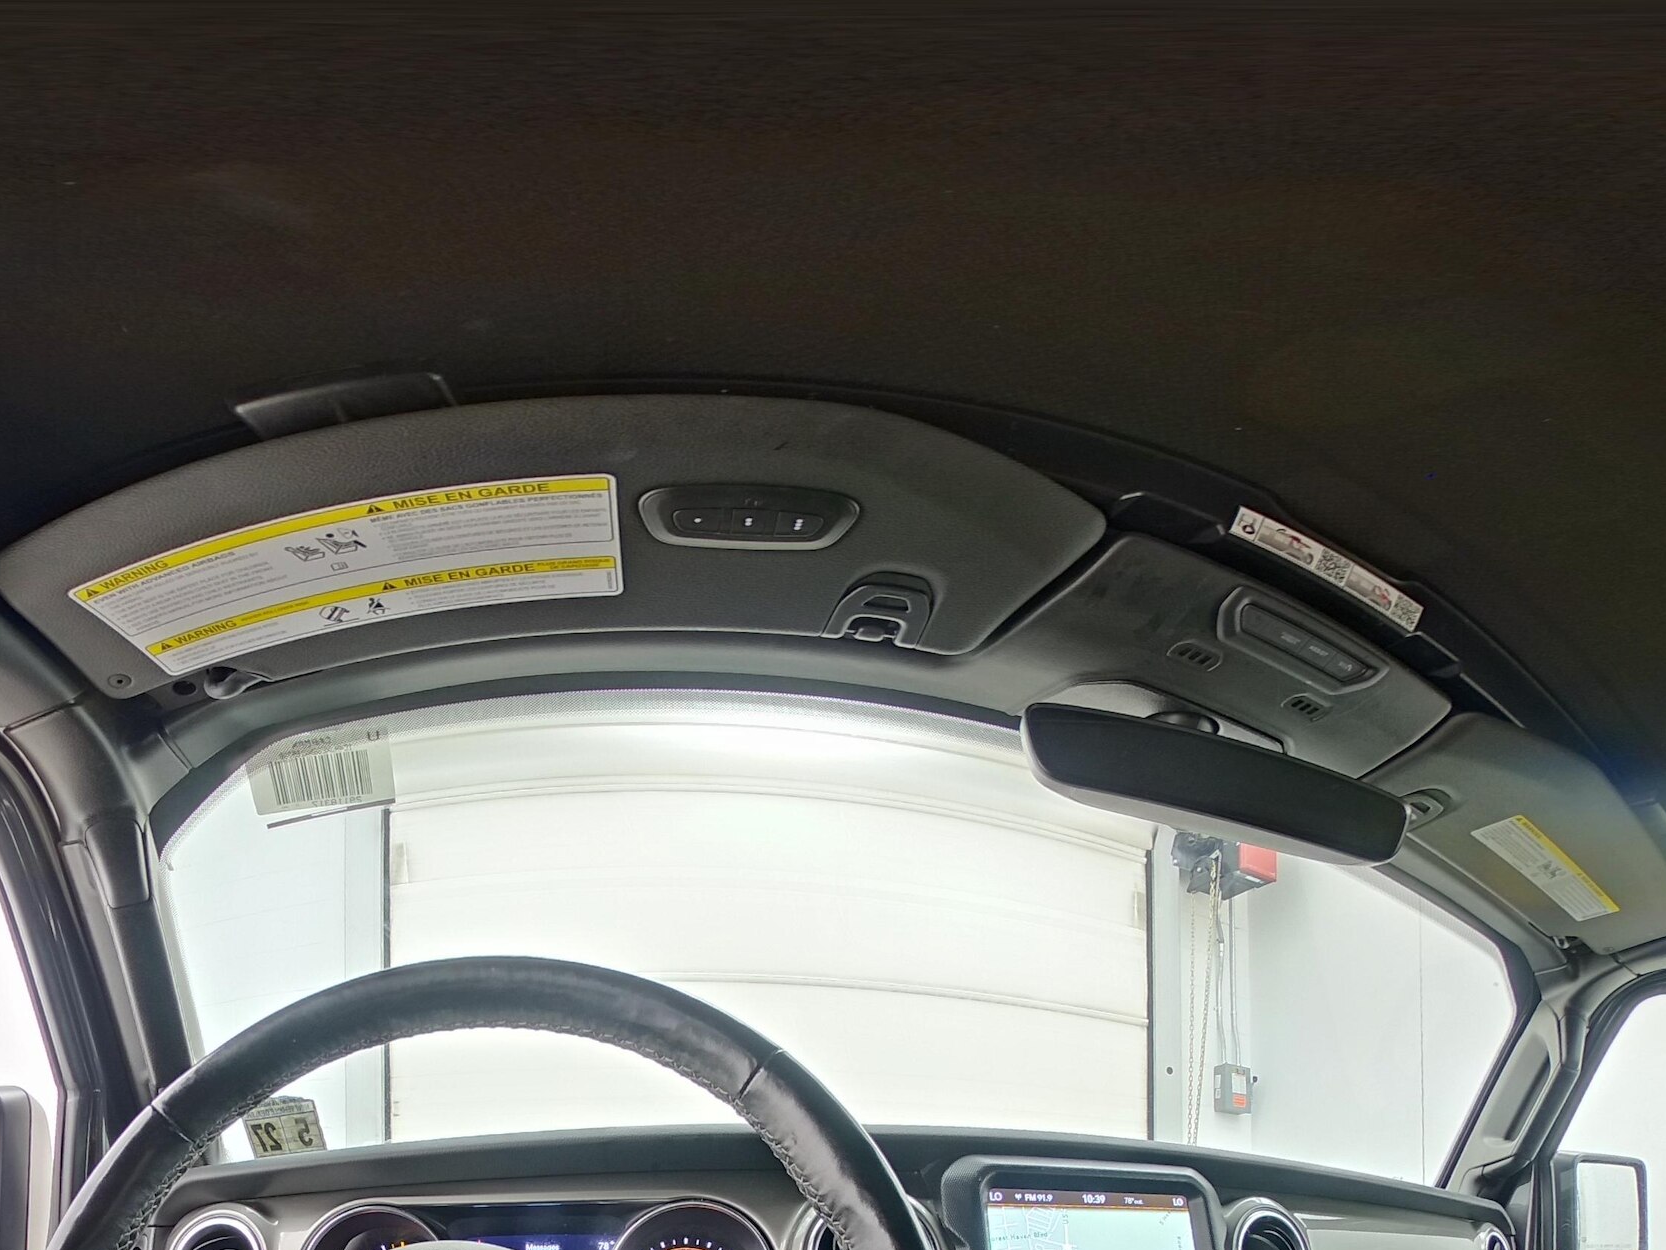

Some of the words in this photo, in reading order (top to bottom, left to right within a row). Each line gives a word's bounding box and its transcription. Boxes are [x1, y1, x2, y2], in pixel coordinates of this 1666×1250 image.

[393, 494, 440, 510] MISE
[445, 490, 472, 501] EN
[478, 482, 550, 498] GARDE
[99, 560, 169, 590] WARNING
[404, 573, 444, 587] MISE
[447, 569, 471, 580] EN
[475, 562, 535, 577] GARDE
[174, 619, 237, 645] WARNING
[989, 1191, 1003, 1202] LO
[1024, 1193, 1037, 1202] FM
[1037, 1193, 1054, 1203] 91.9
[1082, 1193, 1107, 1204] 10:39
[1172, 1197, 1184, 1207] LO
